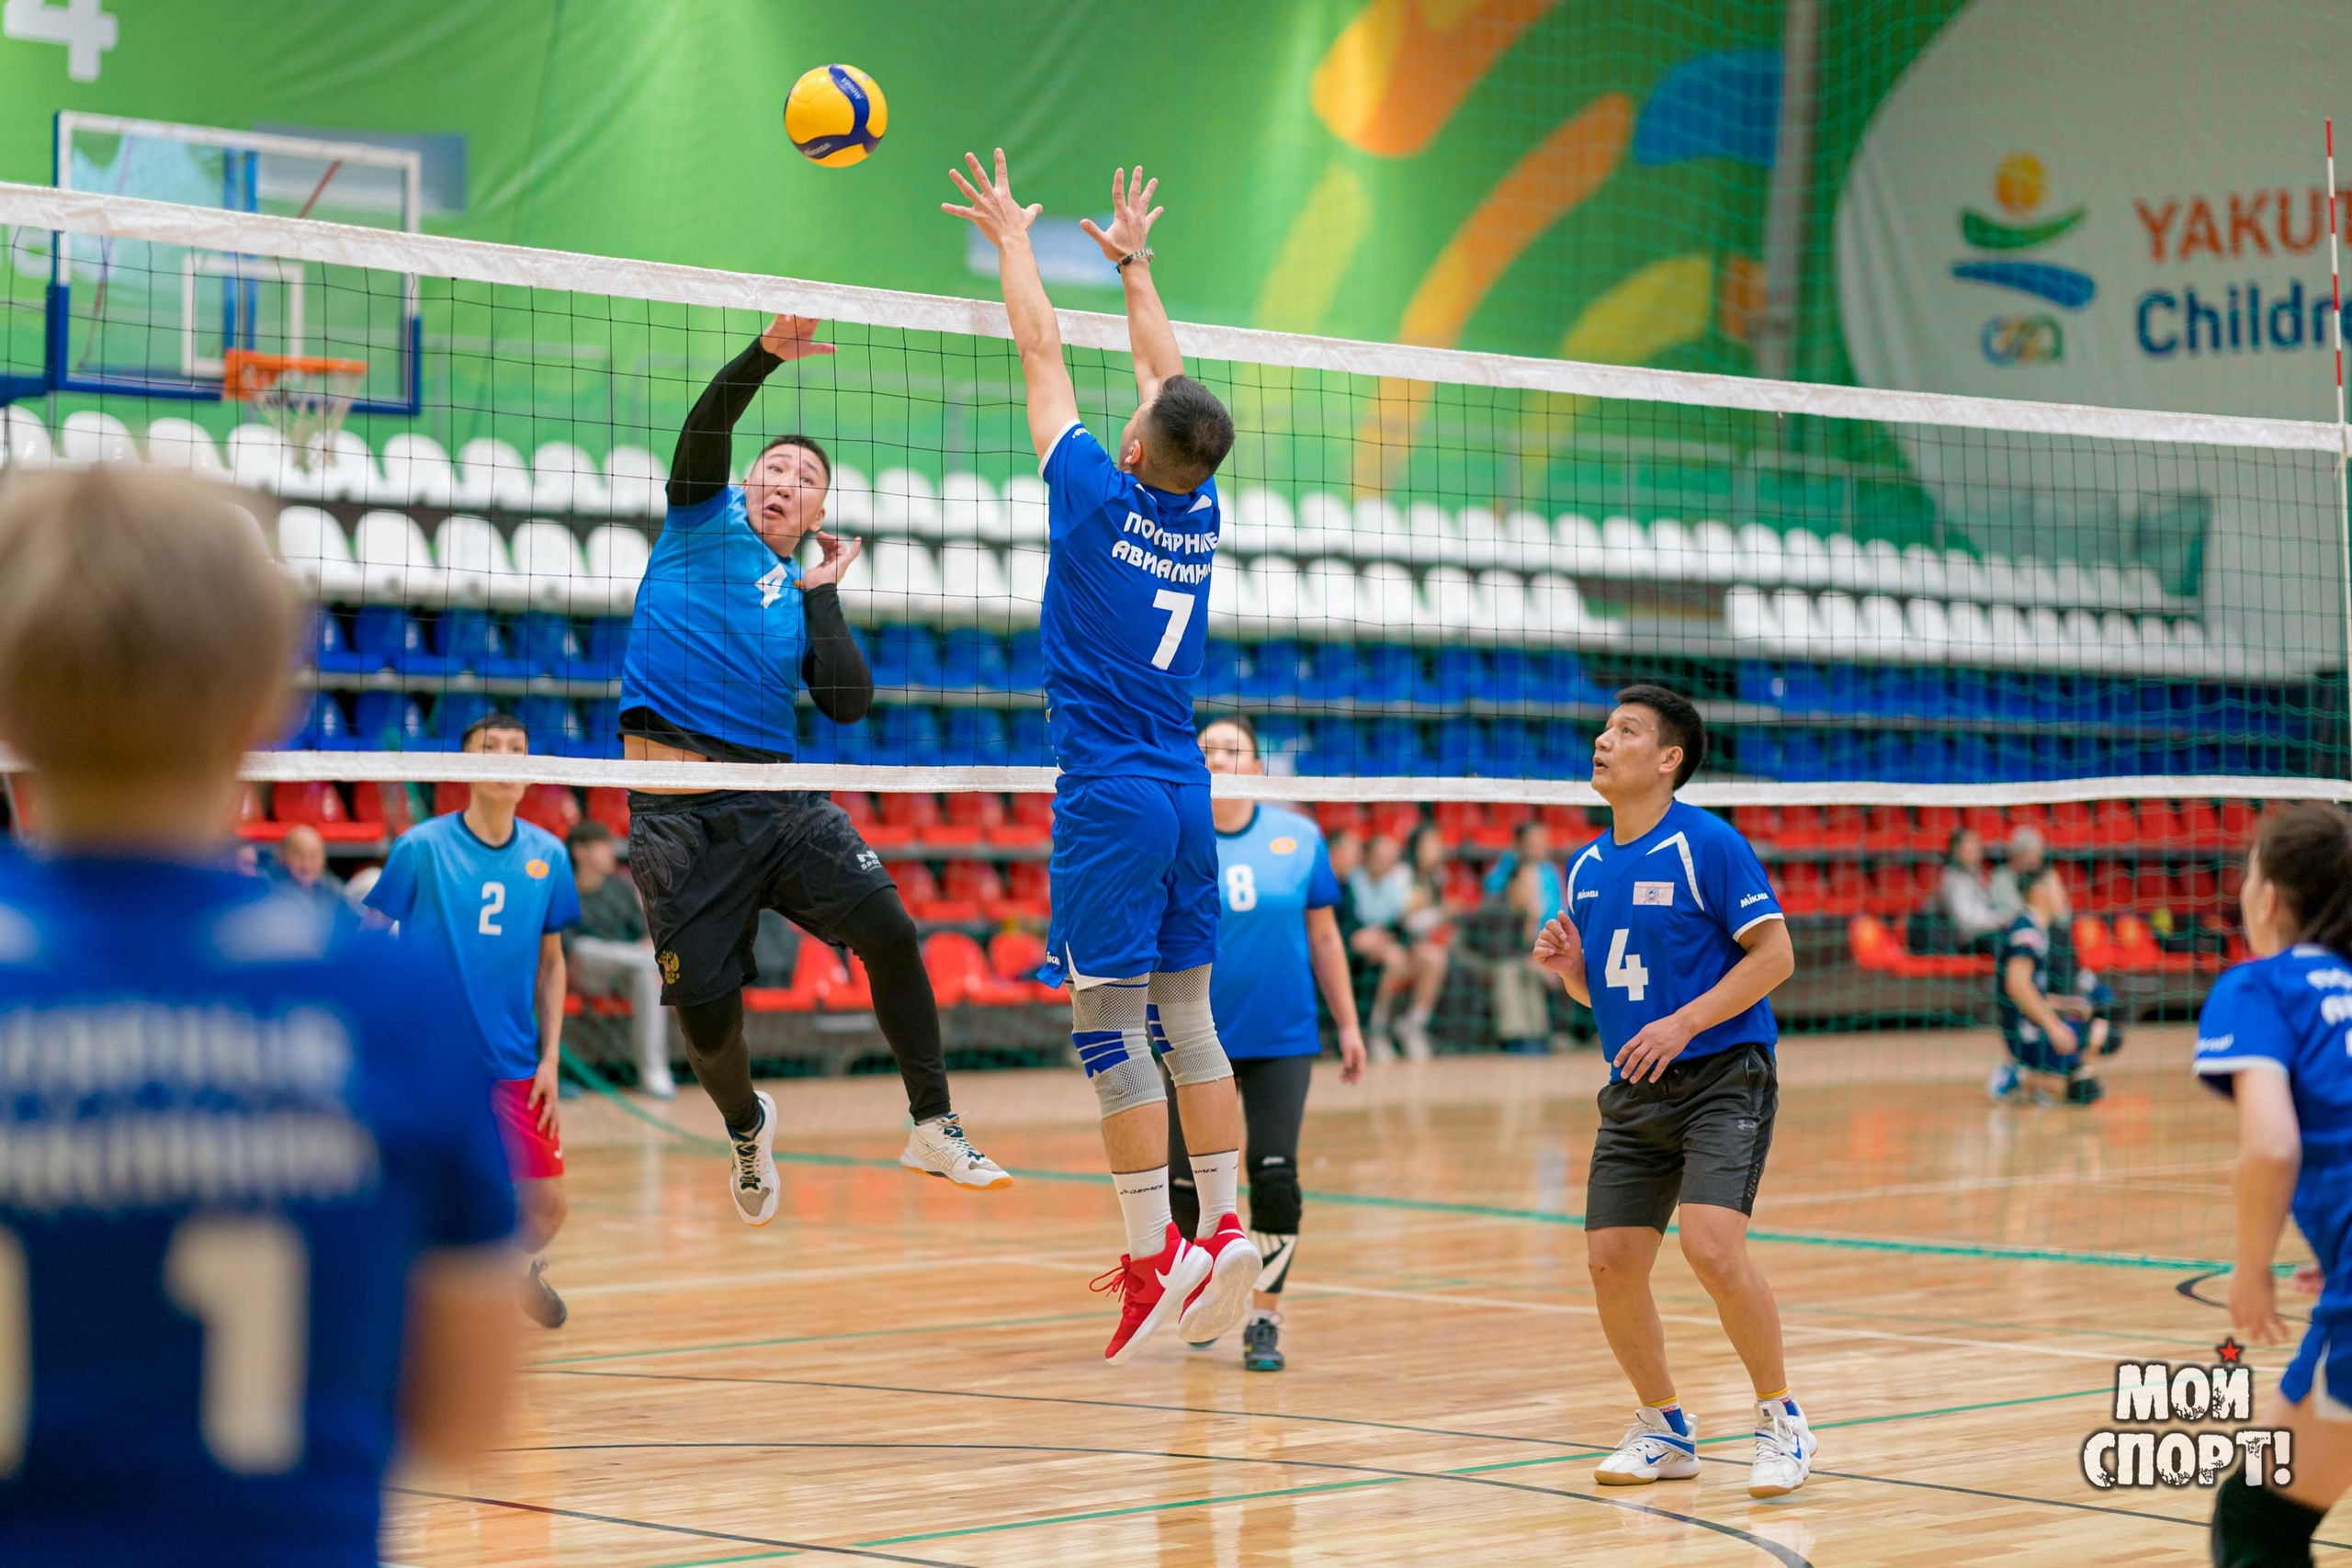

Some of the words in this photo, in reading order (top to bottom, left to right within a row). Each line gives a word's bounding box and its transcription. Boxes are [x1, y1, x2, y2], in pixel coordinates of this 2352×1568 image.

[754, 563, 787, 609] 4
[1151, 589, 1195, 671] 7
[479, 881, 505, 936] 2
[1226, 864, 1257, 912] 8
[1604, 928, 1649, 1002] 4
